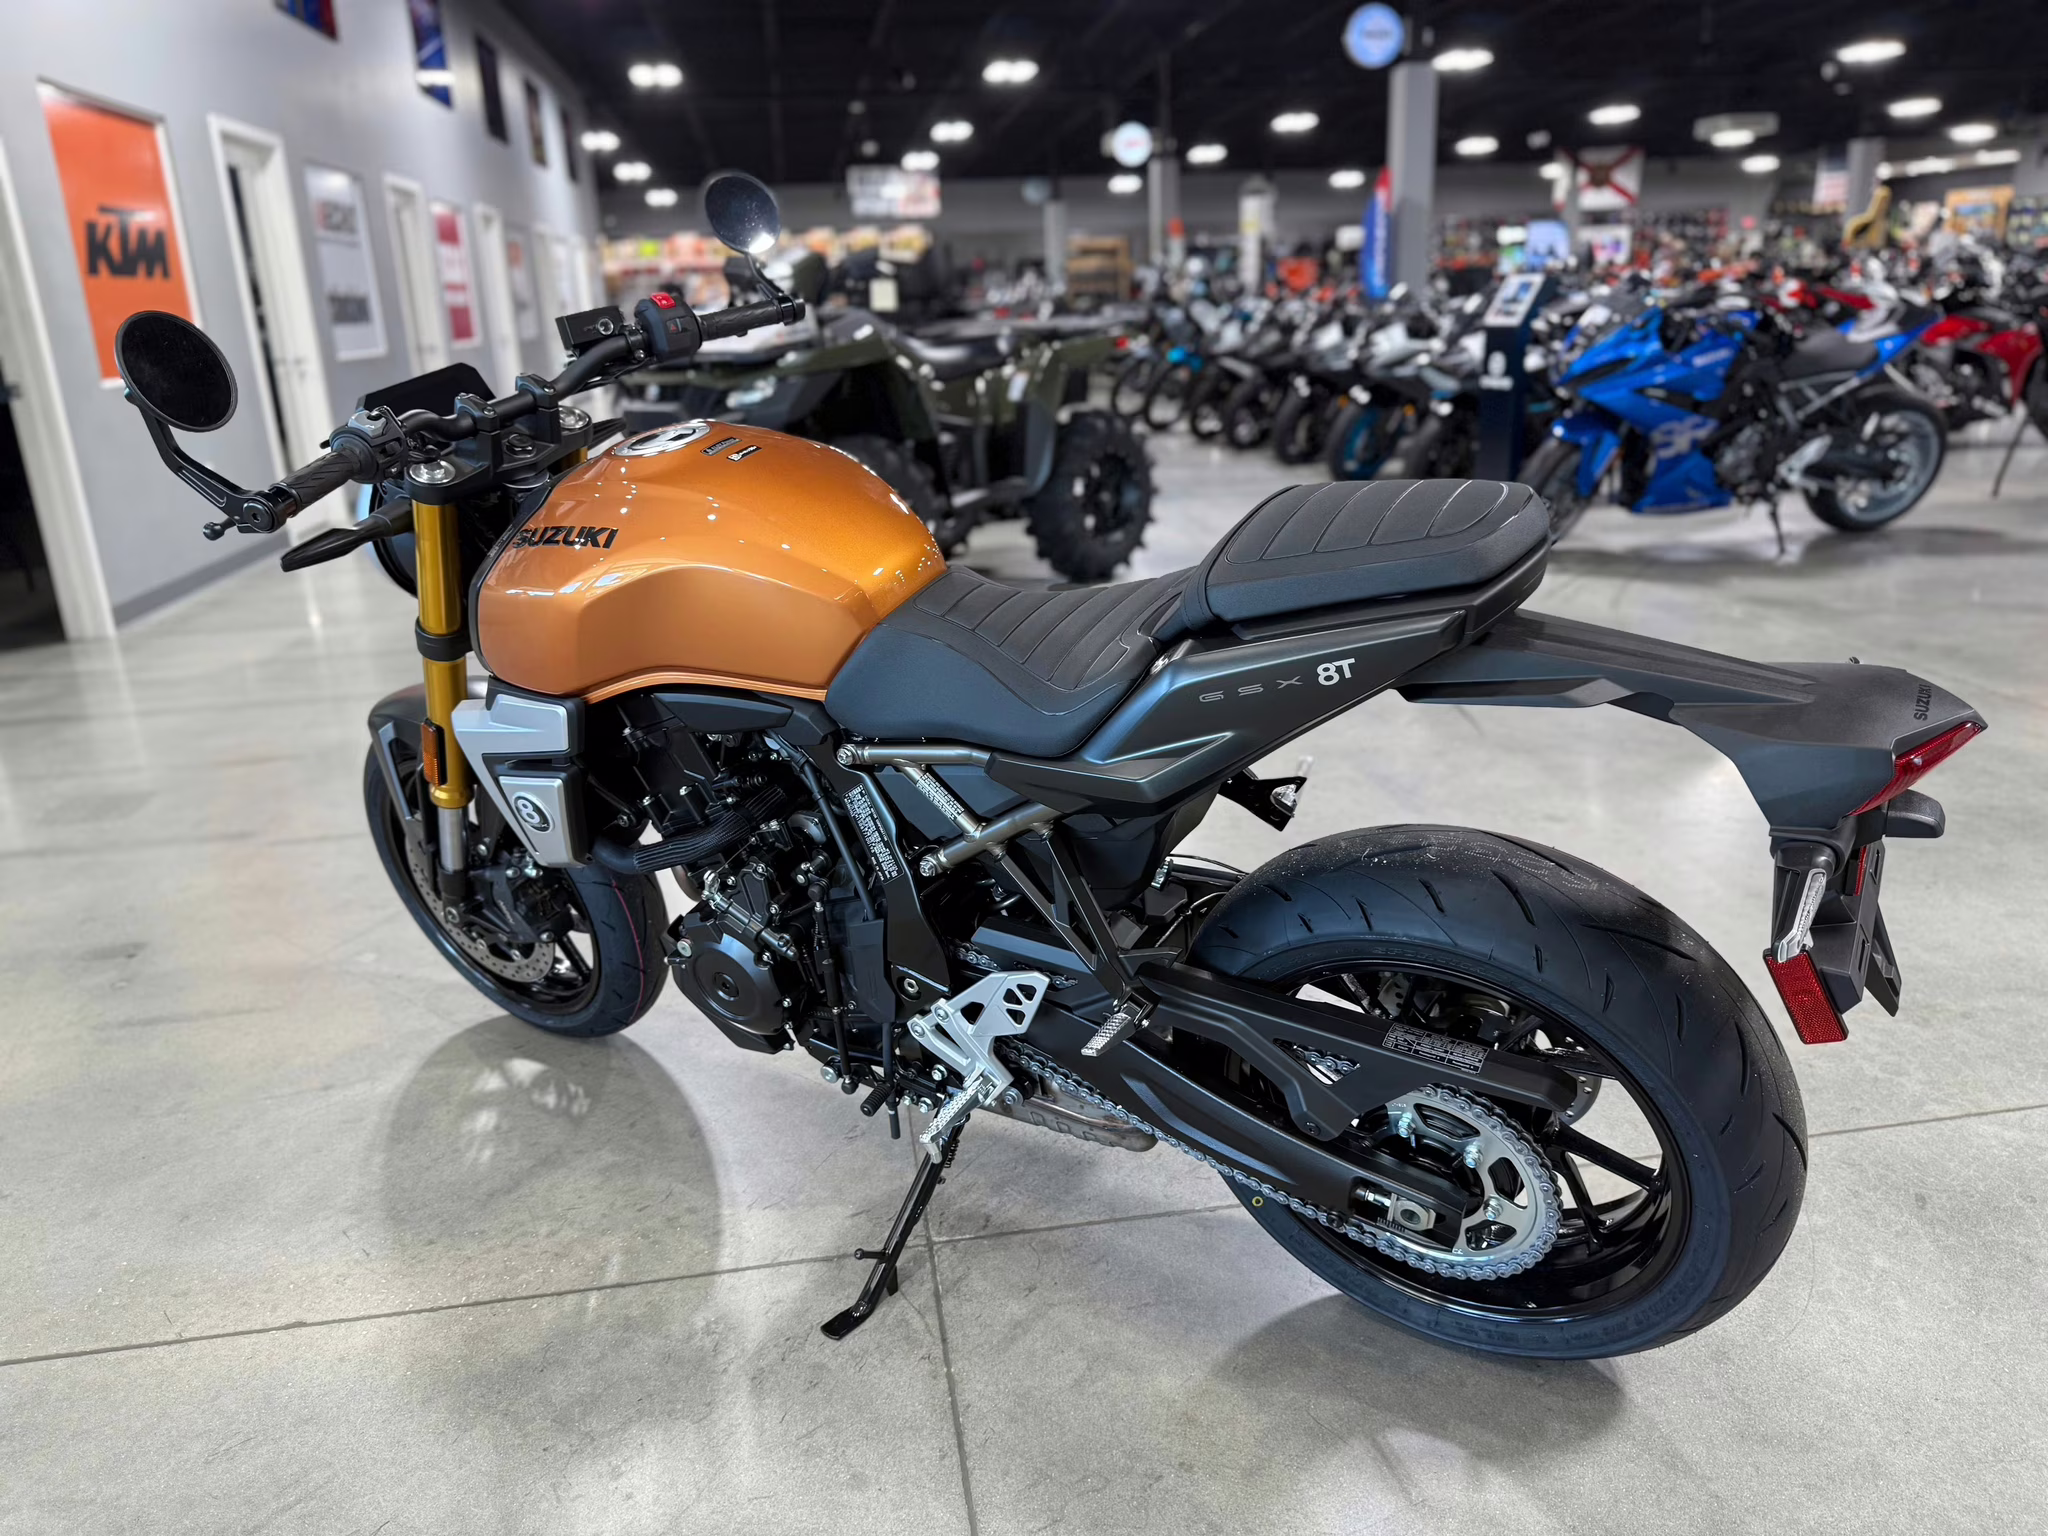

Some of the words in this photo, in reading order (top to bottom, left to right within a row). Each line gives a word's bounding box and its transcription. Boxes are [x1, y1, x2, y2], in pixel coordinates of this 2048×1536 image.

[85, 204, 171, 279] KTM
[512, 525, 619, 549] SUZUKI
[1316, 657, 1356, 686] 8T
[1913, 683, 1932, 721] SUZUKI
[517, 799, 541, 824] 8
